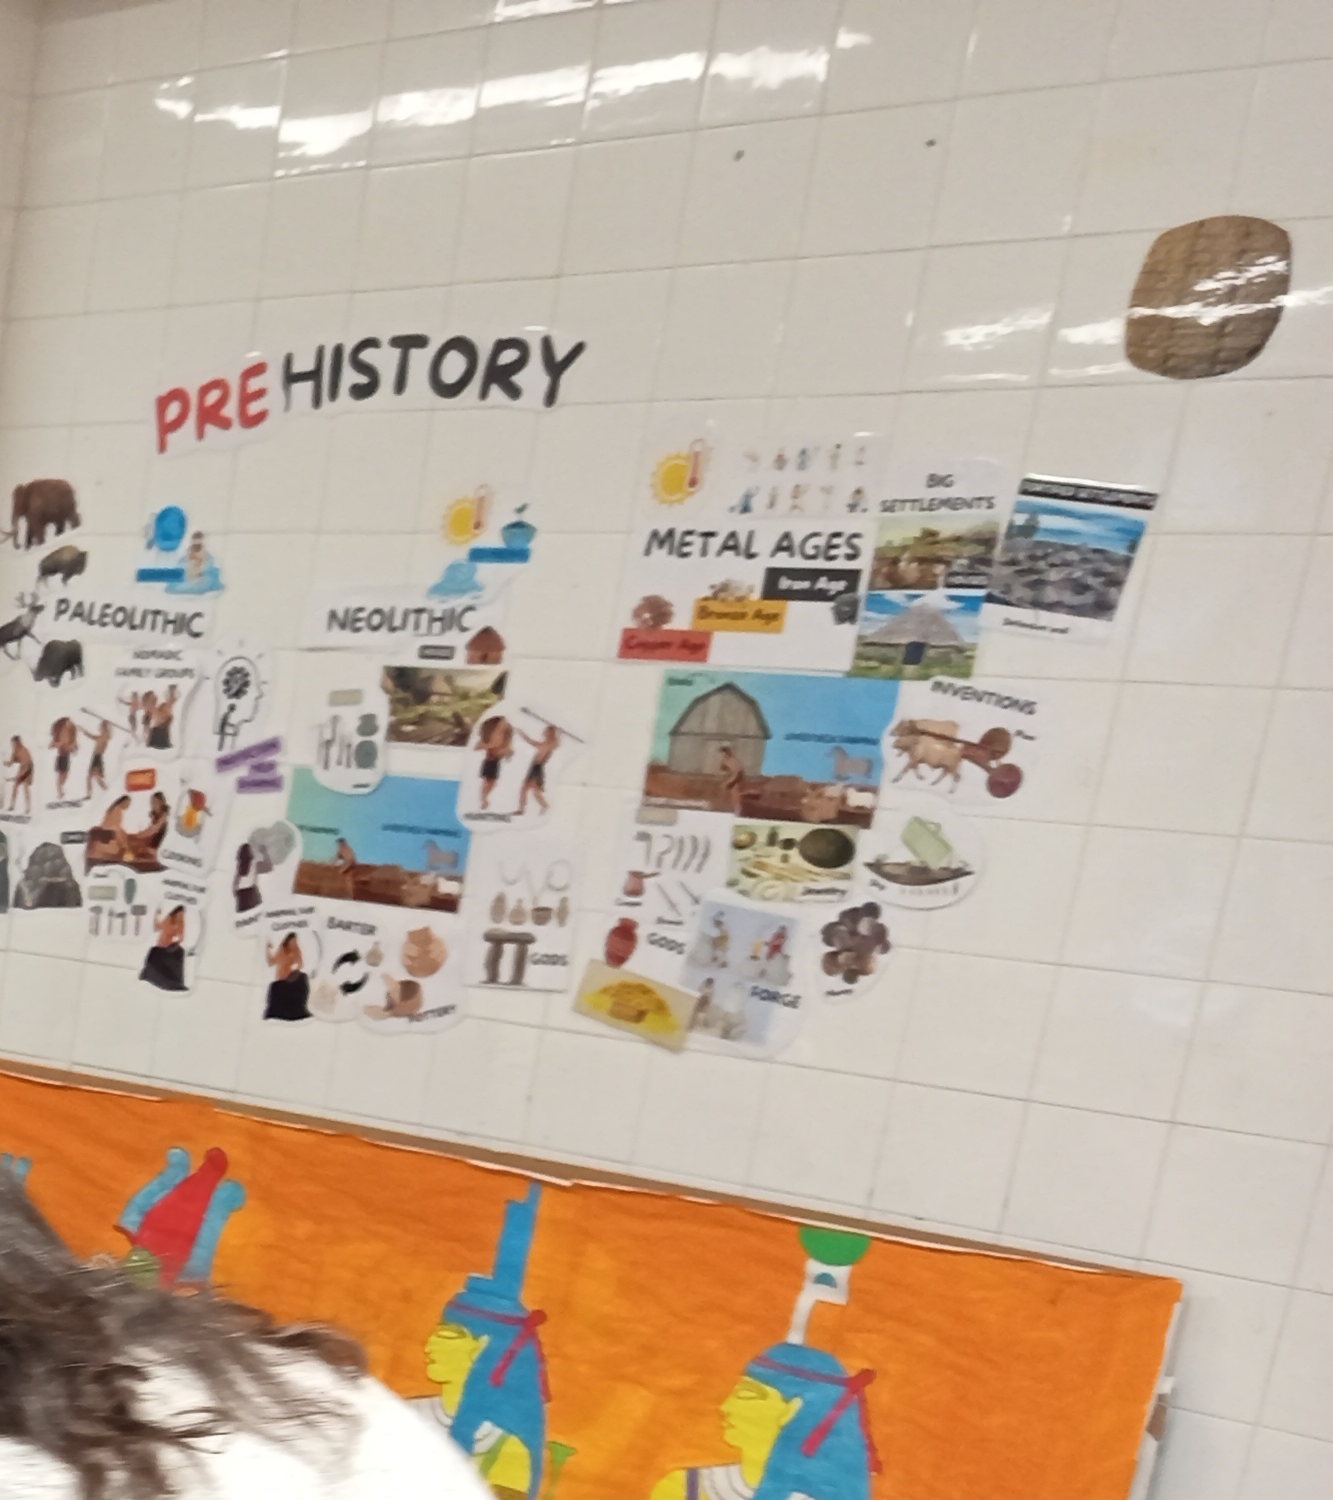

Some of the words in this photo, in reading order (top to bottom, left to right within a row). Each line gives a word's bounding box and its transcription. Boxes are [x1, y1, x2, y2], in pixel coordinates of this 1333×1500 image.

[643, 527, 759, 560] METAL
[770, 530, 865, 561] AGES
[814, 577, 848, 595] Age
[53, 598, 205, 636] PALEOLITHIC
[328, 604, 477, 634] NEOLITHIC
[931, 680, 1037, 715] INVENTIONS
[646, 932, 686, 955] GODS
[750, 985, 801, 1009] FORGE
